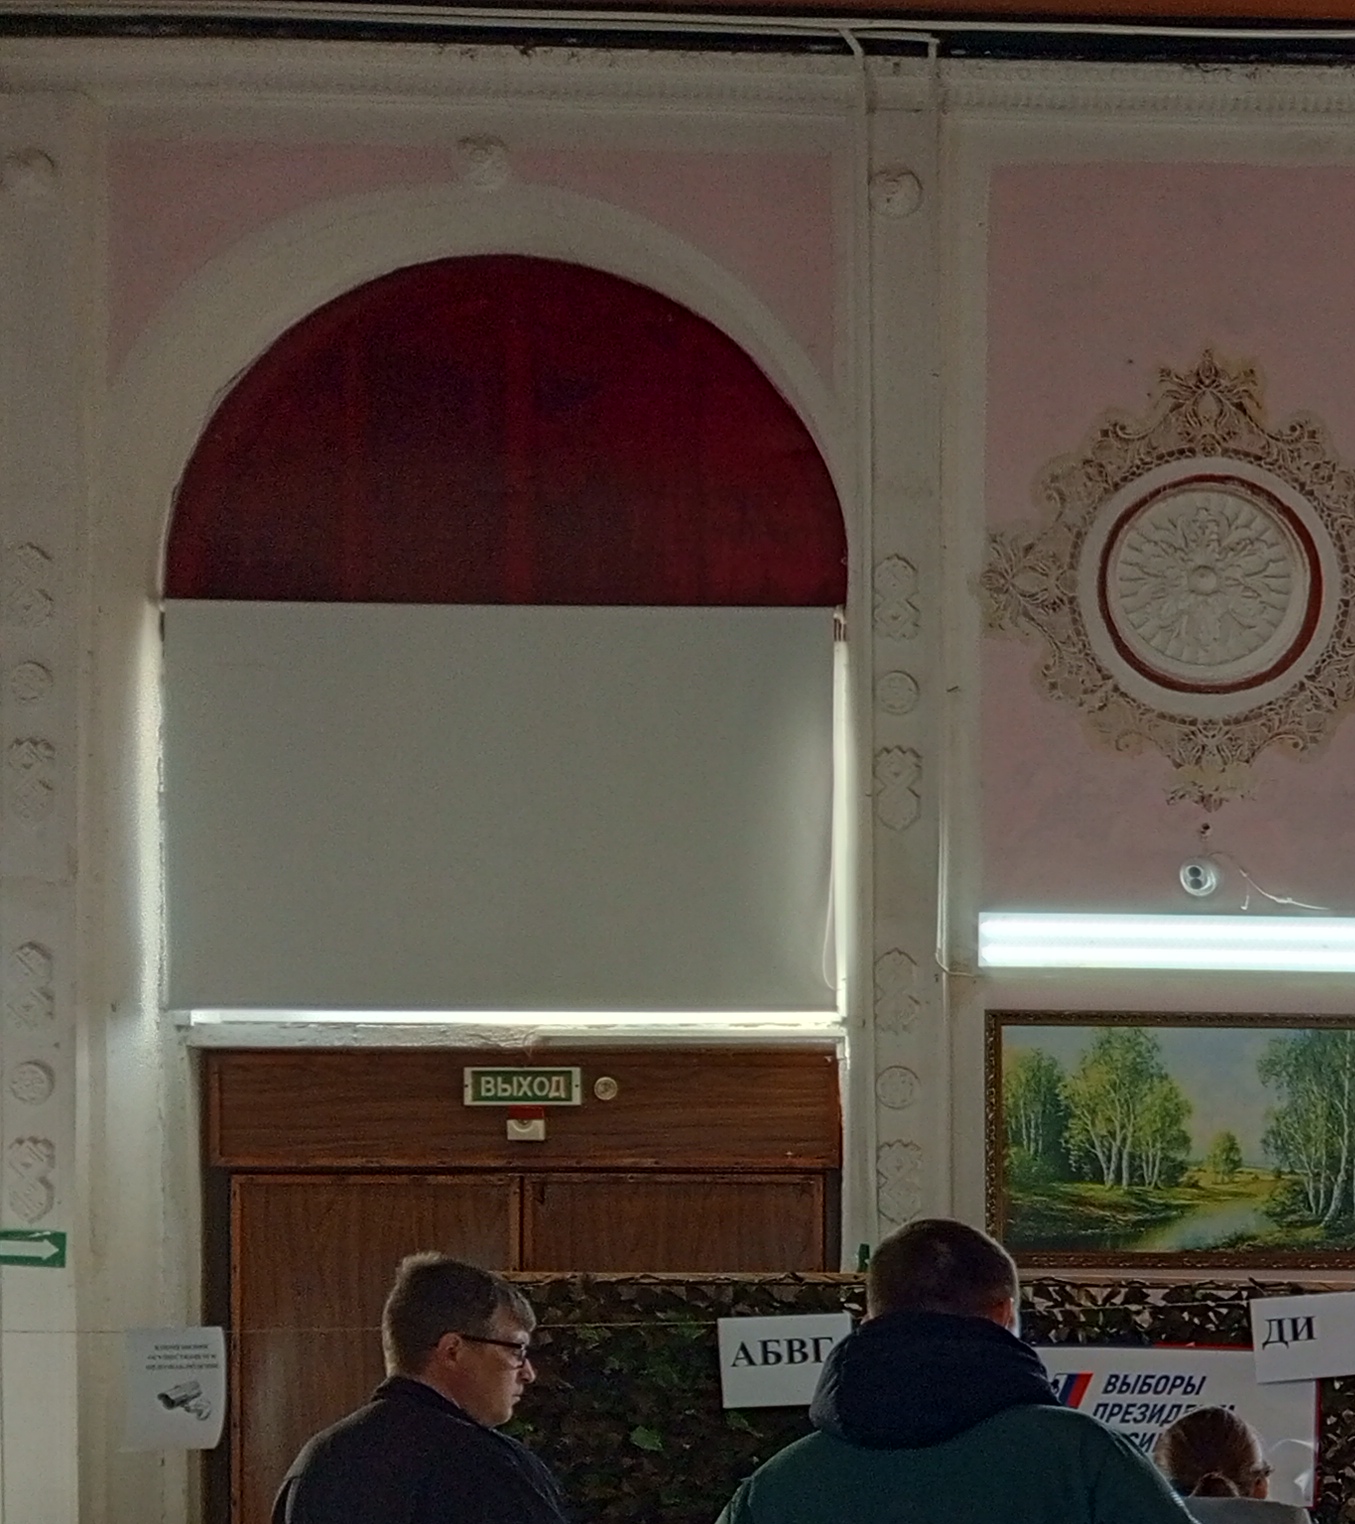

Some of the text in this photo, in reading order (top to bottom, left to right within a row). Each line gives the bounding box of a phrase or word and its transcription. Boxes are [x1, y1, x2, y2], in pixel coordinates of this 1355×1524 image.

[480, 1076, 566, 1098] ВЫХОД
[1262, 1315, 1318, 1350] ДИ
[730, 1336, 834, 1367] АБВГ
[1102, 1374, 1207, 1395] ВЫБОРЫ
